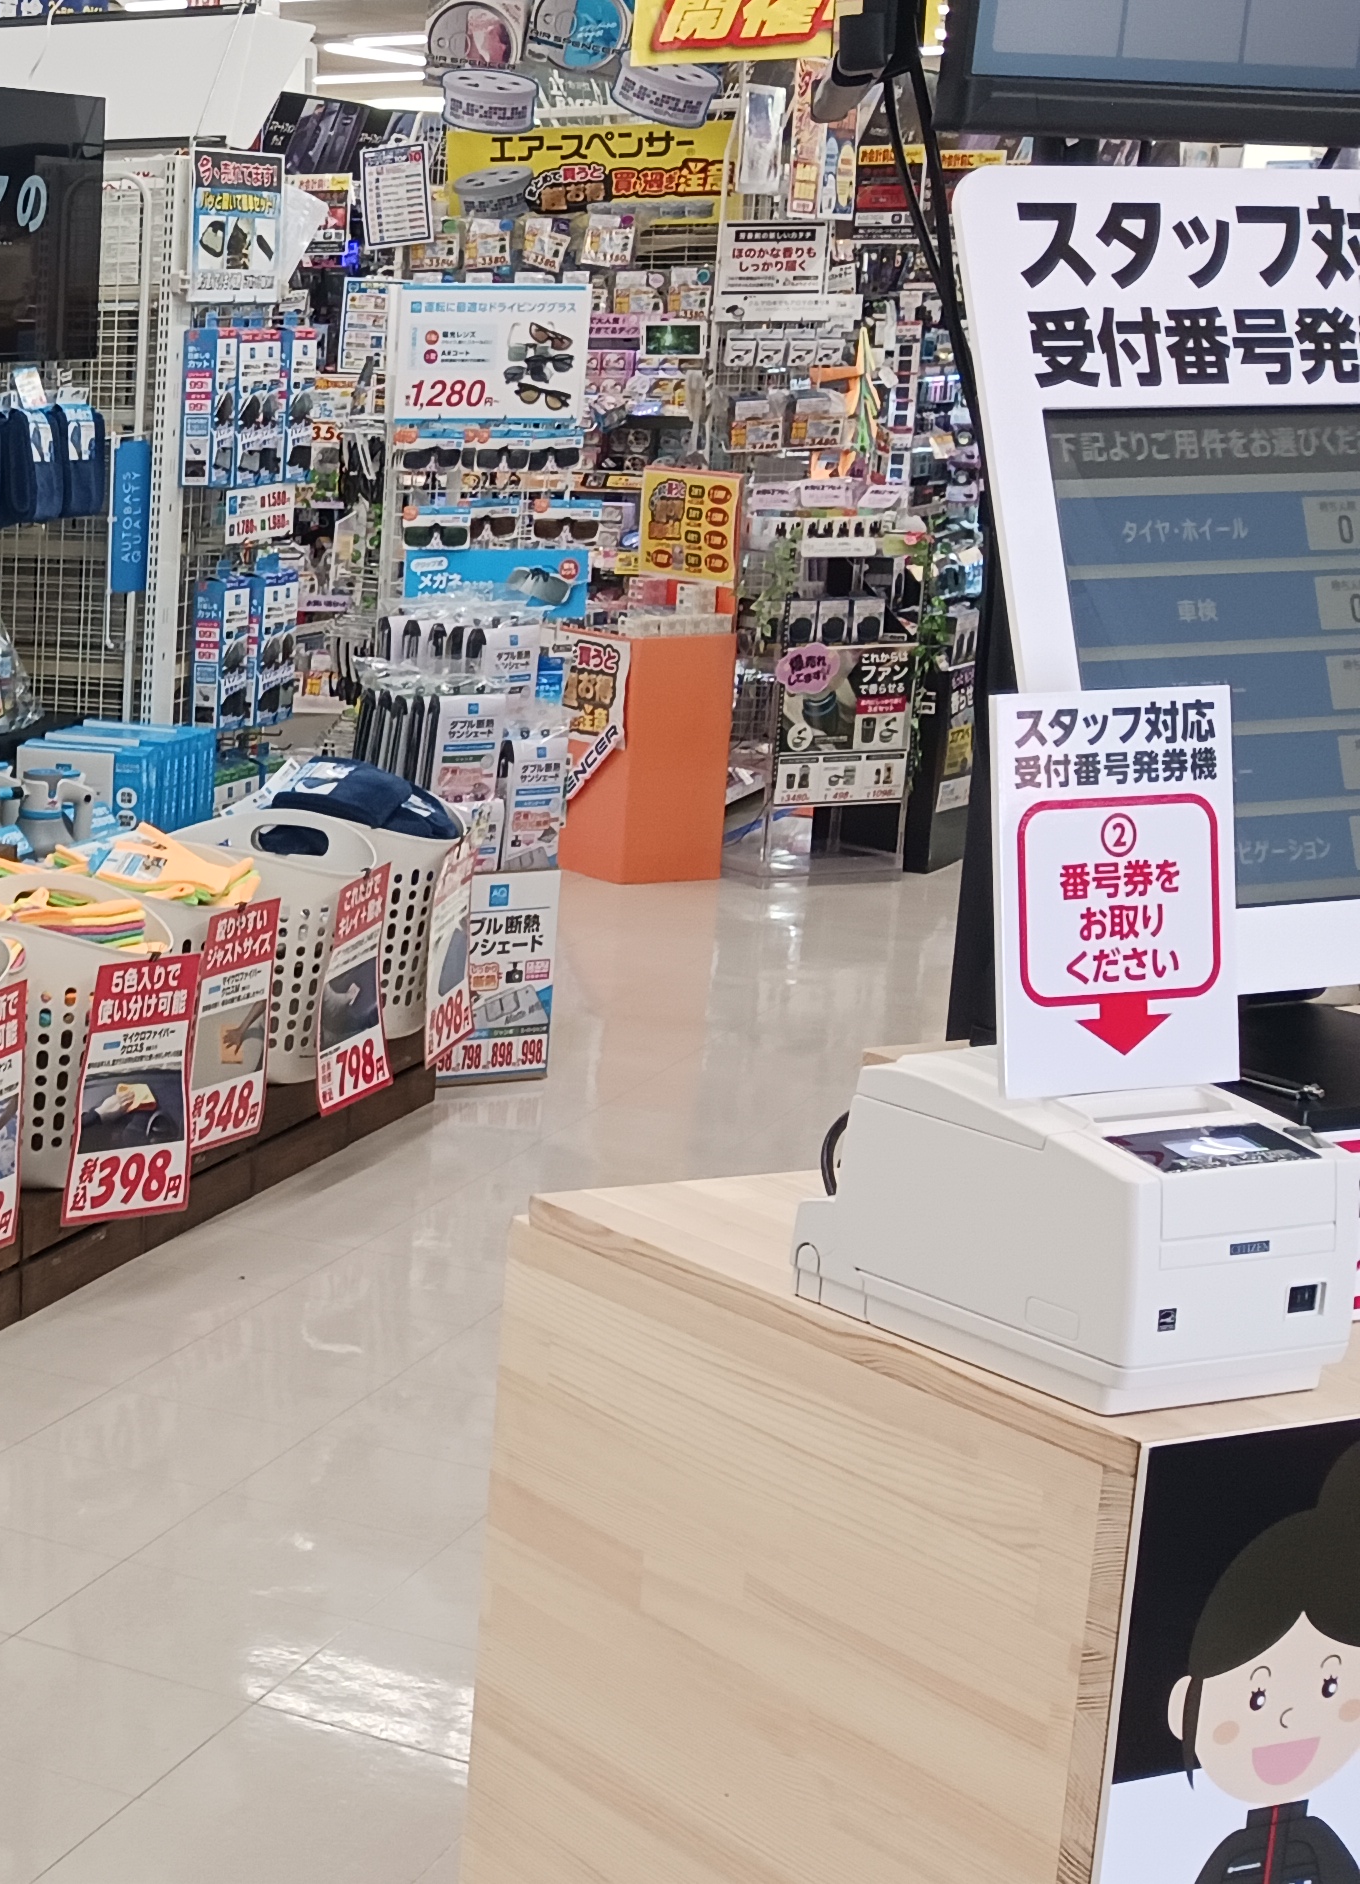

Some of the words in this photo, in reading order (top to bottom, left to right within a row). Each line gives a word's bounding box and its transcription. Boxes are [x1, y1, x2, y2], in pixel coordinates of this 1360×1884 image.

[489, 132, 696, 163] エアースペンサー
[732, 246, 817, 260] ほのかな香りも
[738, 259, 807, 273] しっかり届く
[424, 302, 577, 314] 運転に最適なドライビンググラス
[121, 471, 132, 563] AUTOBACS
[132, 470, 142, 564] QUALITY
[1177, 598, 1219, 624] 車検
[862, 652, 909, 664] これからは
[861, 665, 909, 684] ファン
[1015, 700, 1216, 750] スタッフ対応
[1015, 748, 1218, 791] 受付番号発券機
[1060, 860, 1180, 901] 番号券を
[215, 911, 268, 941] 絞りやすい
[1080, 904, 1165, 942] お取り
[206, 933, 273, 971] ジャストサイズ
[1066, 947, 1180, 986] ください
[111, 965, 180, 995] 5色入りで
[97, 991, 186, 1024] 使い分け可能
[1231, 1242, 1269, 1254] CITIZEN
